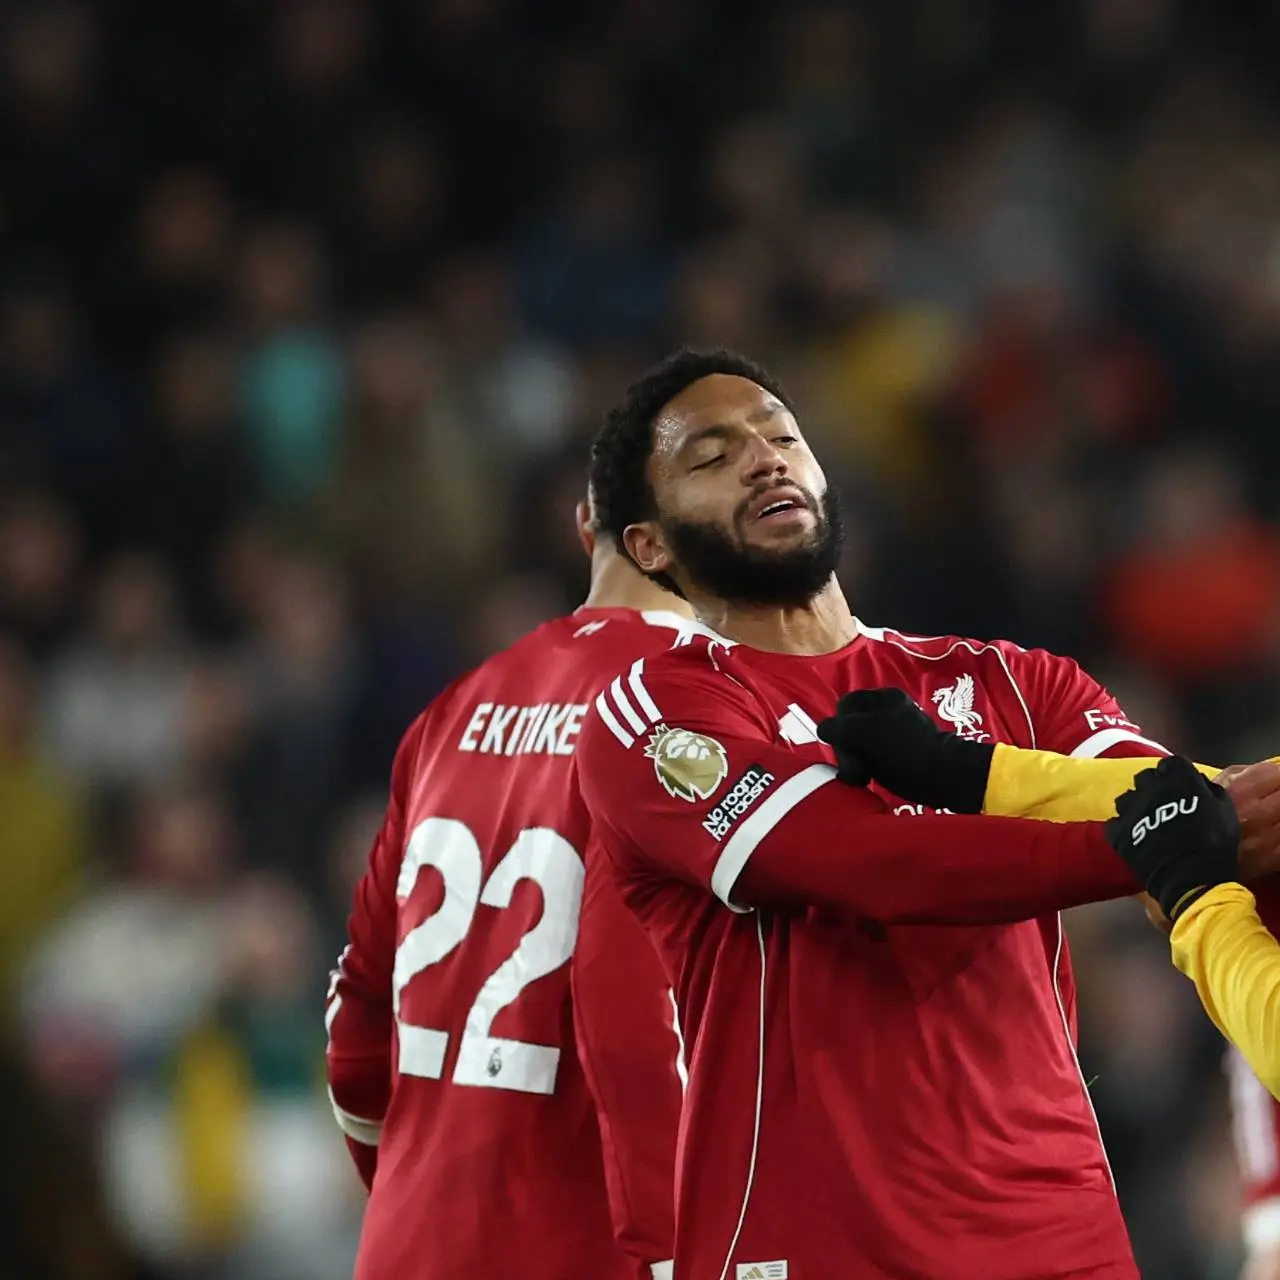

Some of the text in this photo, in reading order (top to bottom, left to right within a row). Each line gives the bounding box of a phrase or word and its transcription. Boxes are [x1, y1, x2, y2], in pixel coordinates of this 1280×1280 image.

[702, 770, 760, 836] No room
[711, 772, 776, 842] for racism
[1131, 795, 1199, 846] SUDU
[394, 816, 586, 1095] 22
